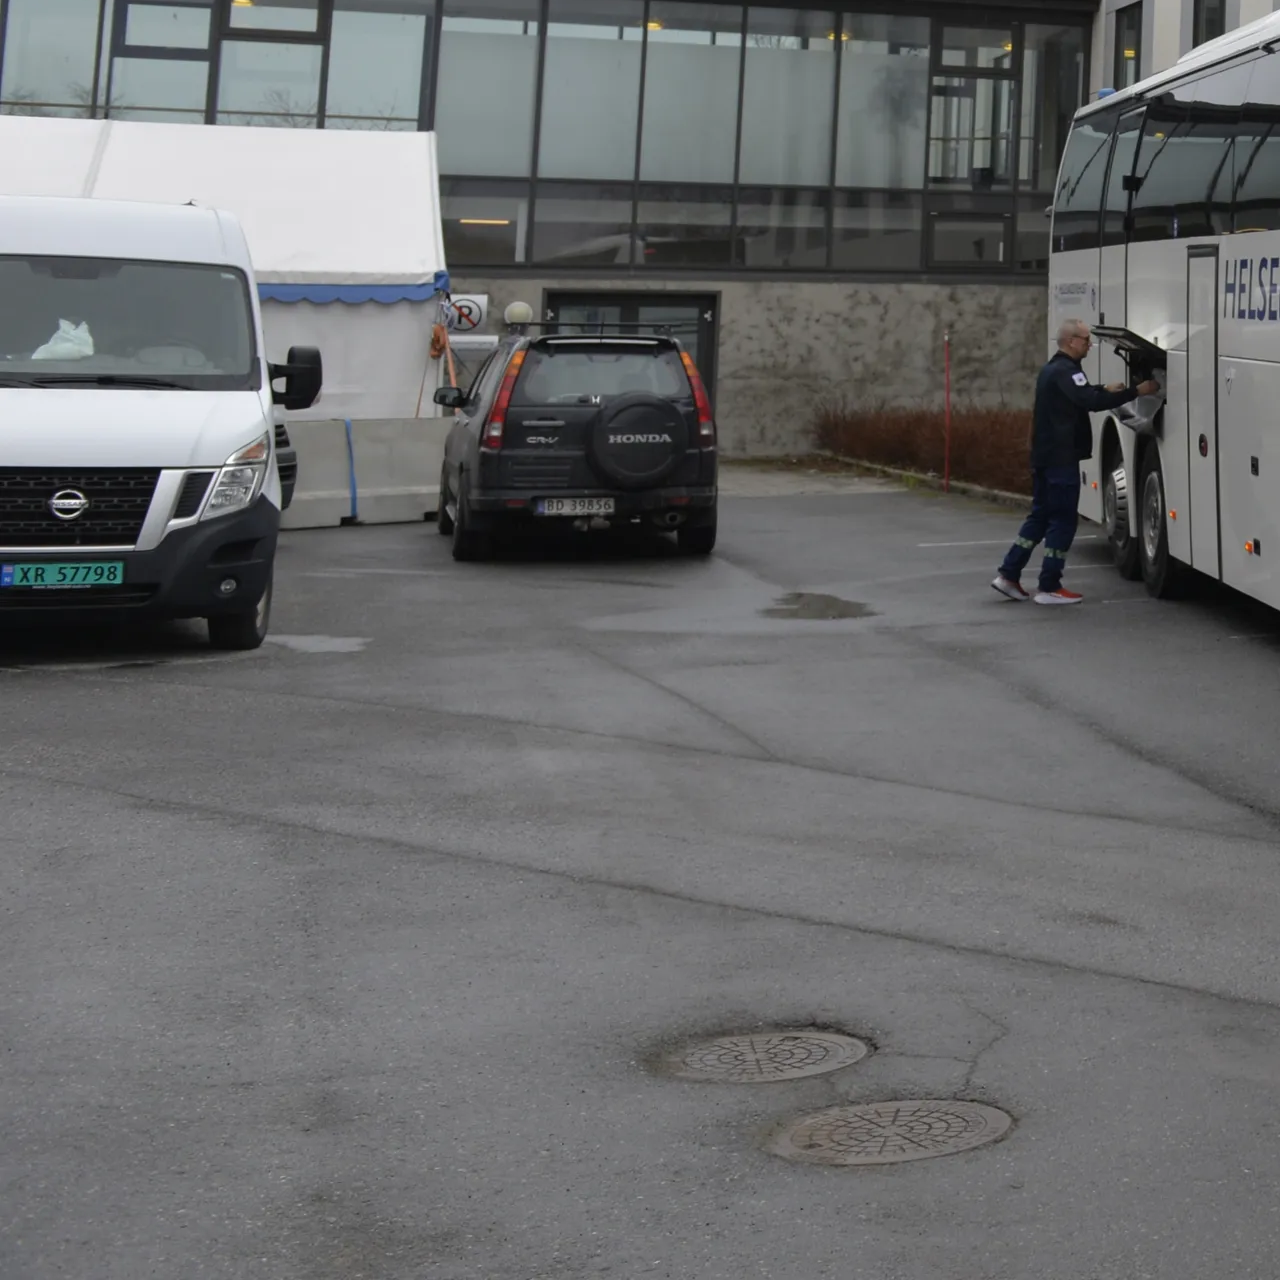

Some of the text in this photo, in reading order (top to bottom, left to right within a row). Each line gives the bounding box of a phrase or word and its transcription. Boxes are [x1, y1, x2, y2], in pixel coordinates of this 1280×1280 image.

[526, 436, 559, 444] CR-V
[608, 434, 672, 444] HONDA
[547, 498, 612, 512] BD 39856
[19, 566, 118, 583] XR 57798
